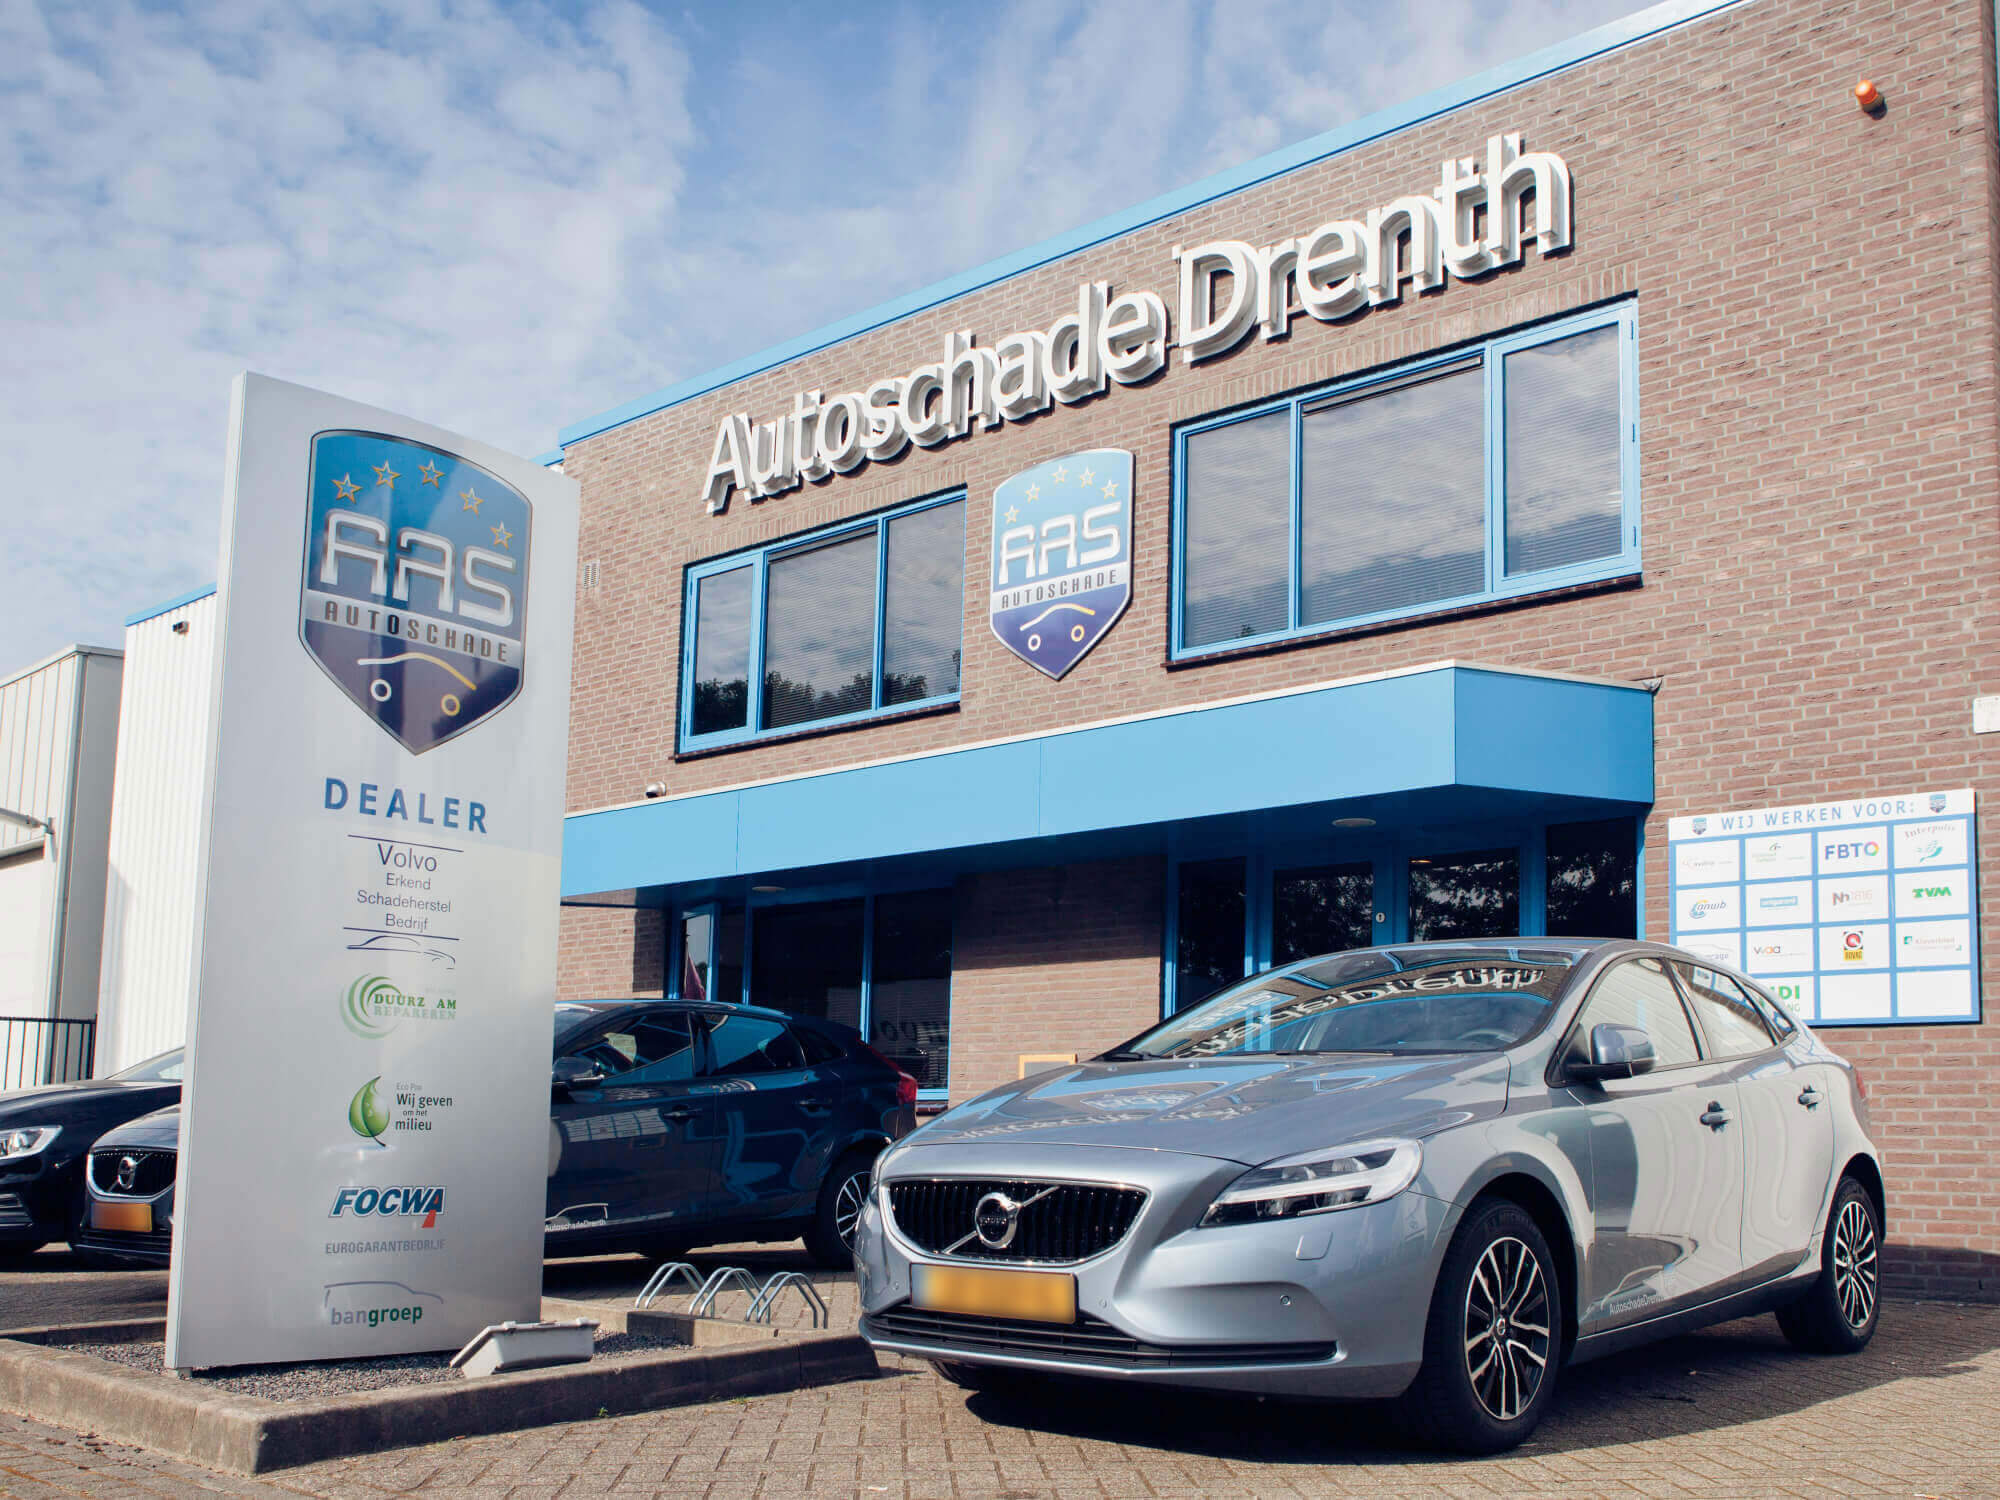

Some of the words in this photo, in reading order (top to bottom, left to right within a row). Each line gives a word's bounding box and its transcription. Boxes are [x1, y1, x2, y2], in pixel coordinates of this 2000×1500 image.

[699, 279, 1169, 516] Autoschade
[1172, 131, 1574, 364] Drenth
[998, 501, 1122, 585] AAS
[319, 508, 517, 628] AAS
[1001, 569, 1118, 610] AUTOSCHADE
[324, 600, 509, 663] AUTOSCHADE
[324, 777, 488, 835] DEALER
[1721, 815, 1754, 831] WIJ
[1764, 806, 1842, 826] WERKEN
[1853, 800, 1915, 818] VOOR:
[377, 843, 438, 872] Volvo
[1824, 841, 1880, 861] FBTO
[386, 872, 432, 891] Erkend
[357, 889, 452, 913] Schadeherstel
[385, 913, 430, 933] Bedrijf
[396, 1093, 416, 1109] Wij
[418, 1096, 453, 1109] geven
[416, 1108, 428, 1117] het
[395, 1118, 432, 1131] milieu
[329, 1187, 446, 1229] FOCWA
[331, 1306, 423, 1328] bangroep
